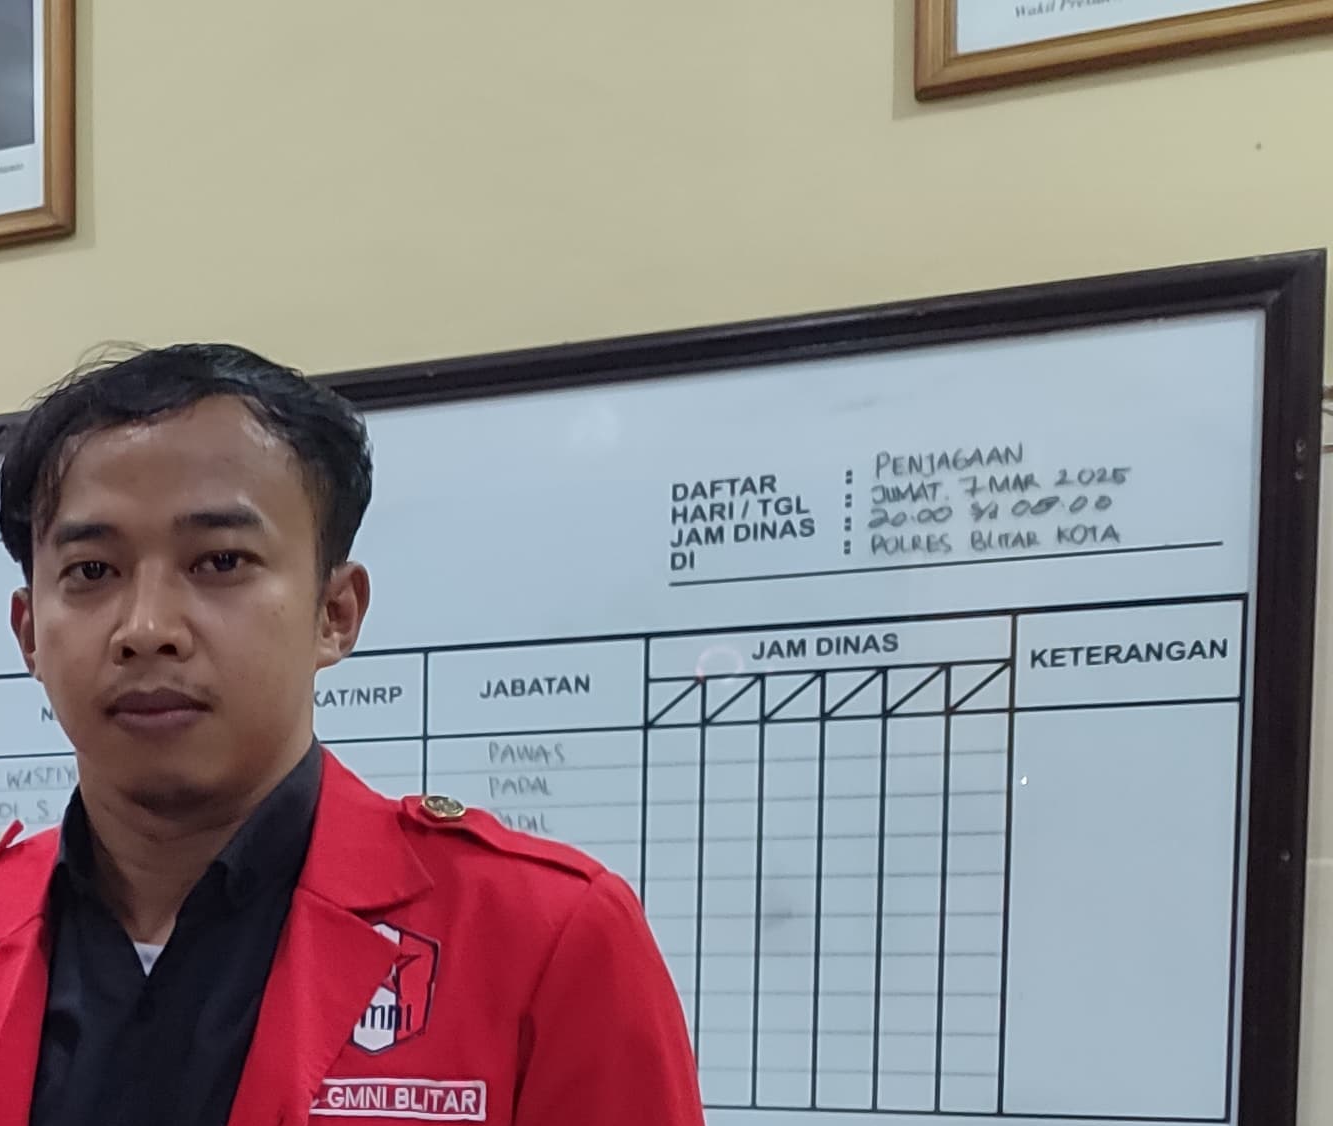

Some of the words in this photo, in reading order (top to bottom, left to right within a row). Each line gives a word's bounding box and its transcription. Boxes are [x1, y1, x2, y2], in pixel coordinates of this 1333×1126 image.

[671, 474, 777, 502] DAFTAR
[874, 442, 1025, 480] PENJAGAAN
[671, 499, 735, 525] HARI
[758, 496, 812, 518] TGL
[959, 475, 985, 498] 7
[989, 472, 1041, 493] MAR
[1054, 466, 1132, 486] 2025
[670, 522, 729, 549] JAM
[733, 517, 816, 541] DINAS
[670, 550, 696, 572] DI
[871, 533, 952, 555] POLRES
[1056, 523, 1121, 546] KOTA
[313, 684, 404, 708] KAT/NRP
[479, 673, 591, 700] JABATAN
[751, 637, 808, 662] JAM
[814, 632, 900, 657] DINAS
[1029, 637, 1229, 671] KETERANGAN
[327, 1086, 388, 1110] GMNI
[394, 1086, 477, 1113] BLITAR
